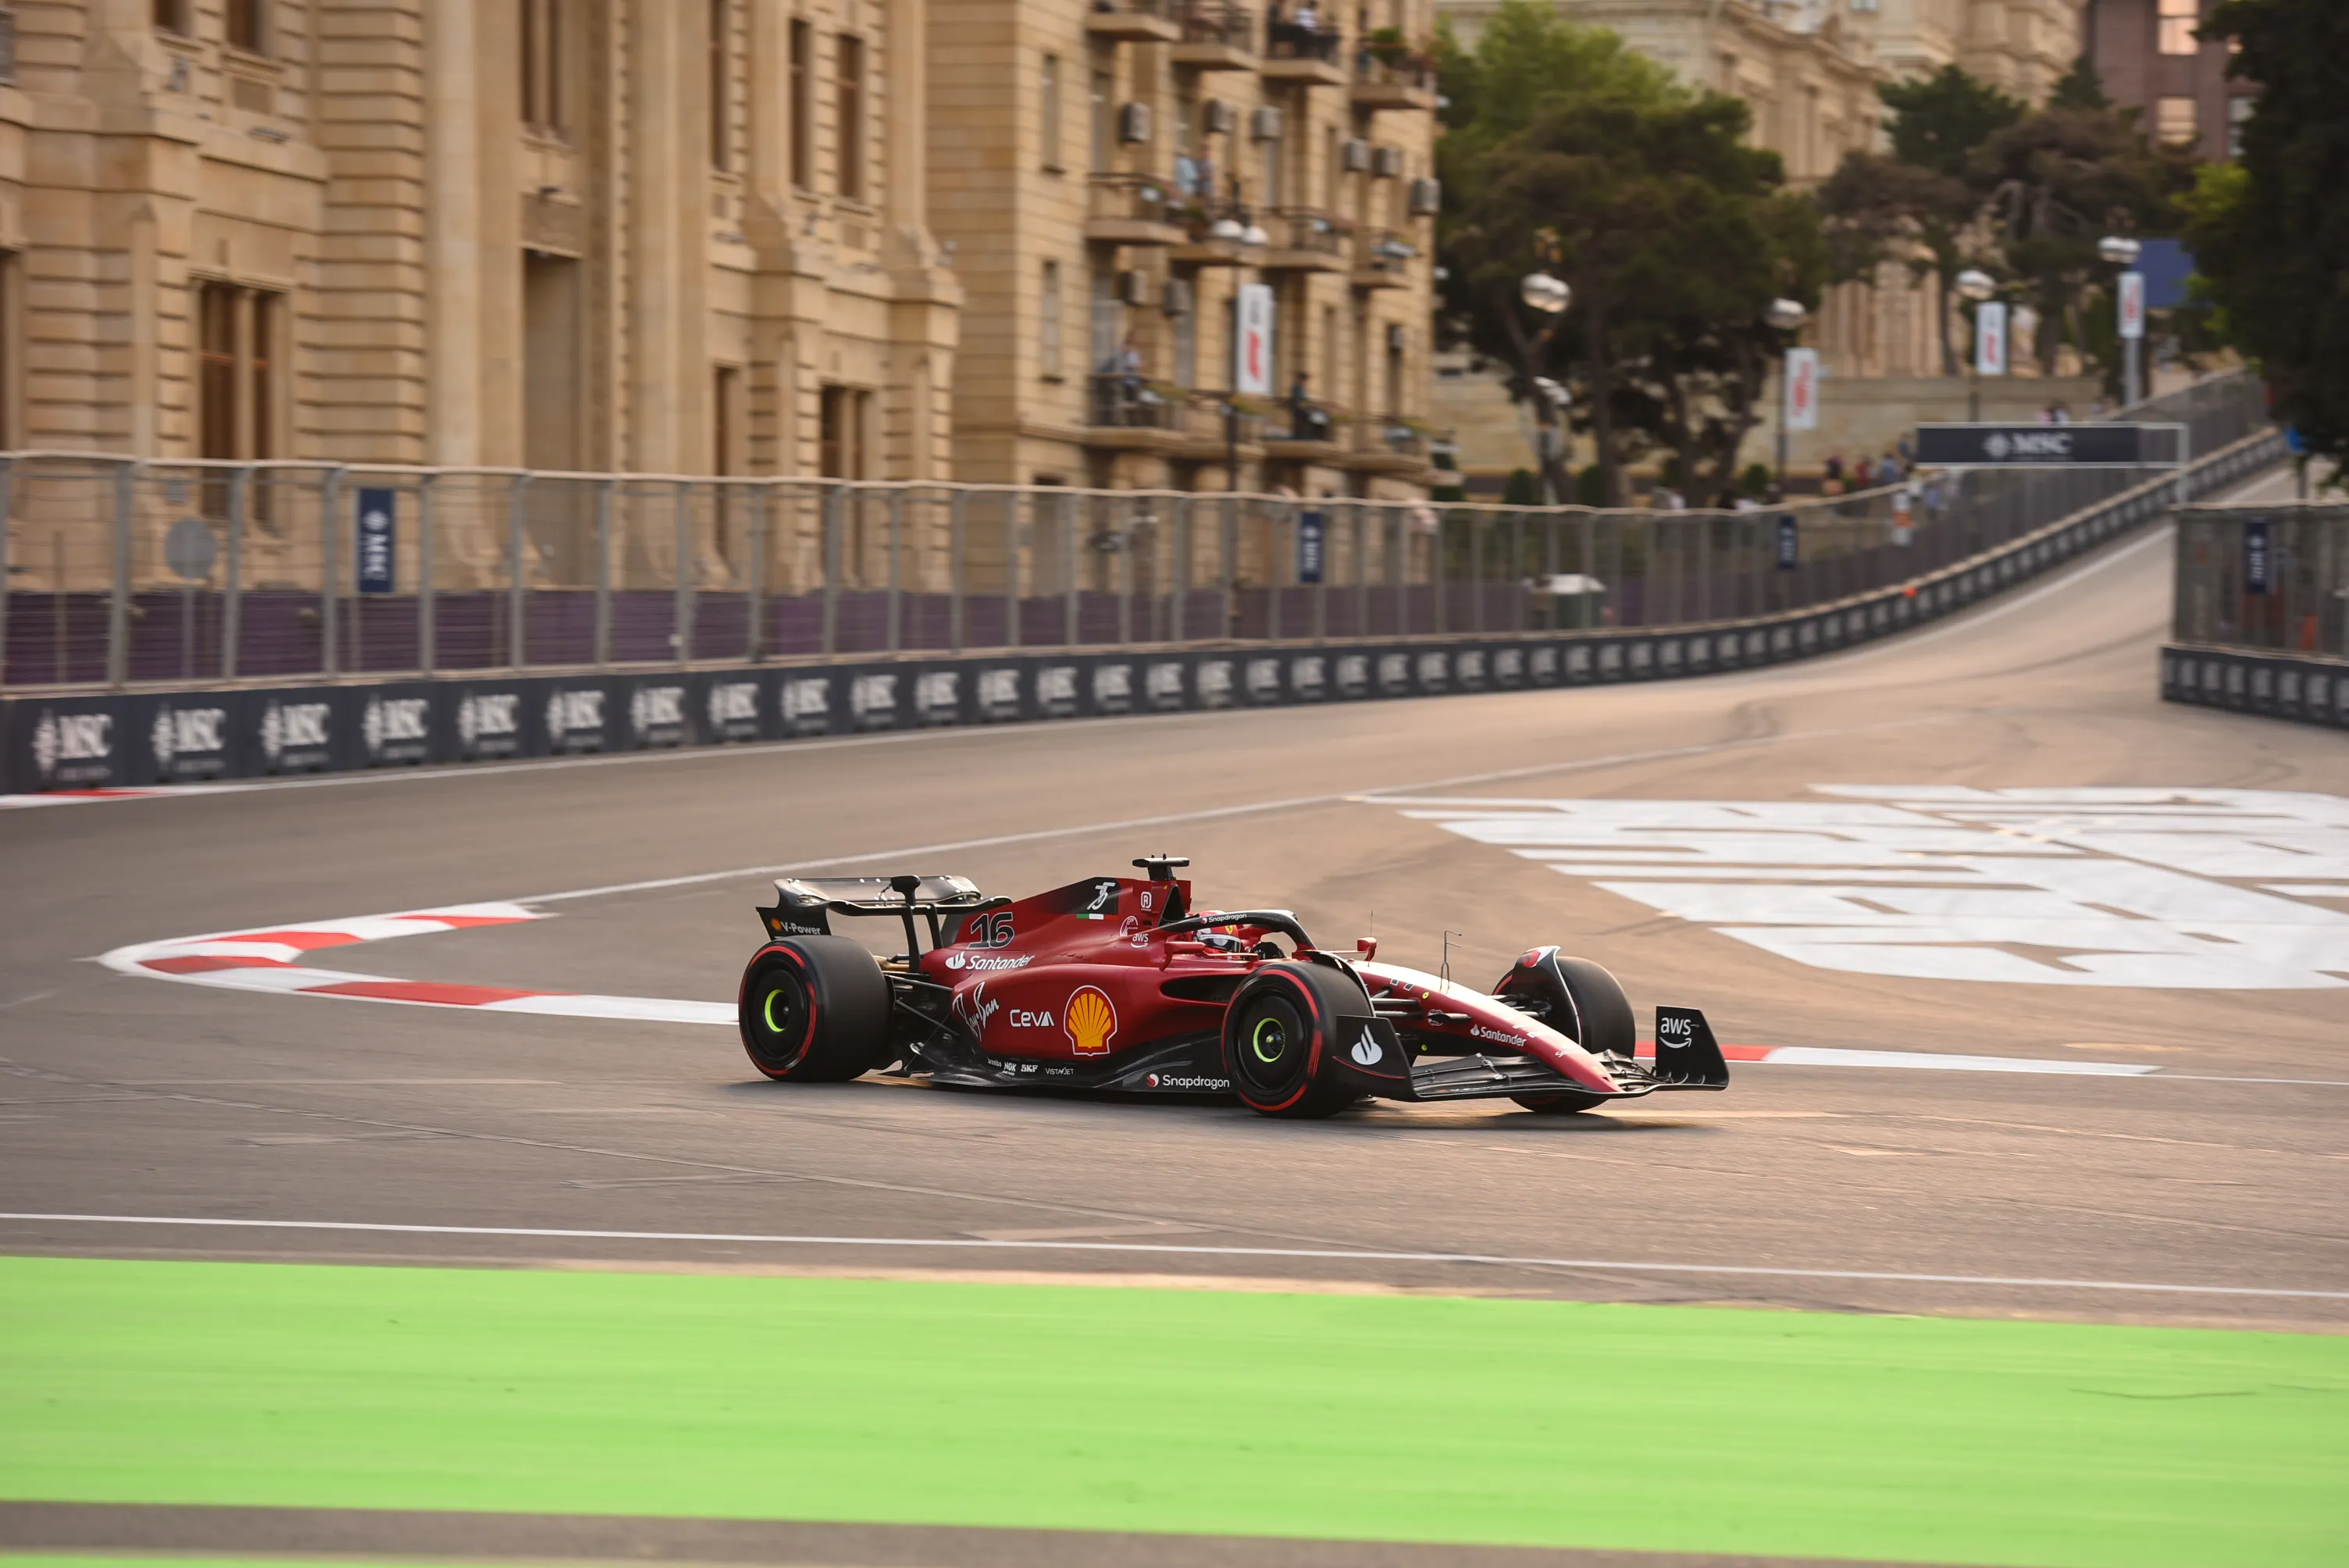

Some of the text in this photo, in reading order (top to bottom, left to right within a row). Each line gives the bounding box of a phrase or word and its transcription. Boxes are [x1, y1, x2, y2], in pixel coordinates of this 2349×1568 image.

[1208, 913, 1247, 923] Snapdragon
[780, 921, 821, 935] V-Power
[966, 911, 1015, 949] 16
[1132, 933, 1149, 943] aws
[966, 954, 1035, 971] Santander
[1660, 1017, 1691, 1035] aws
[1480, 1026, 1527, 1047] Santander
[1003, 1061, 1017, 1072] NGK
[1021, 1064, 1039, 1073] SKF
[1162, 1074, 1230, 1090] Snapdragon
